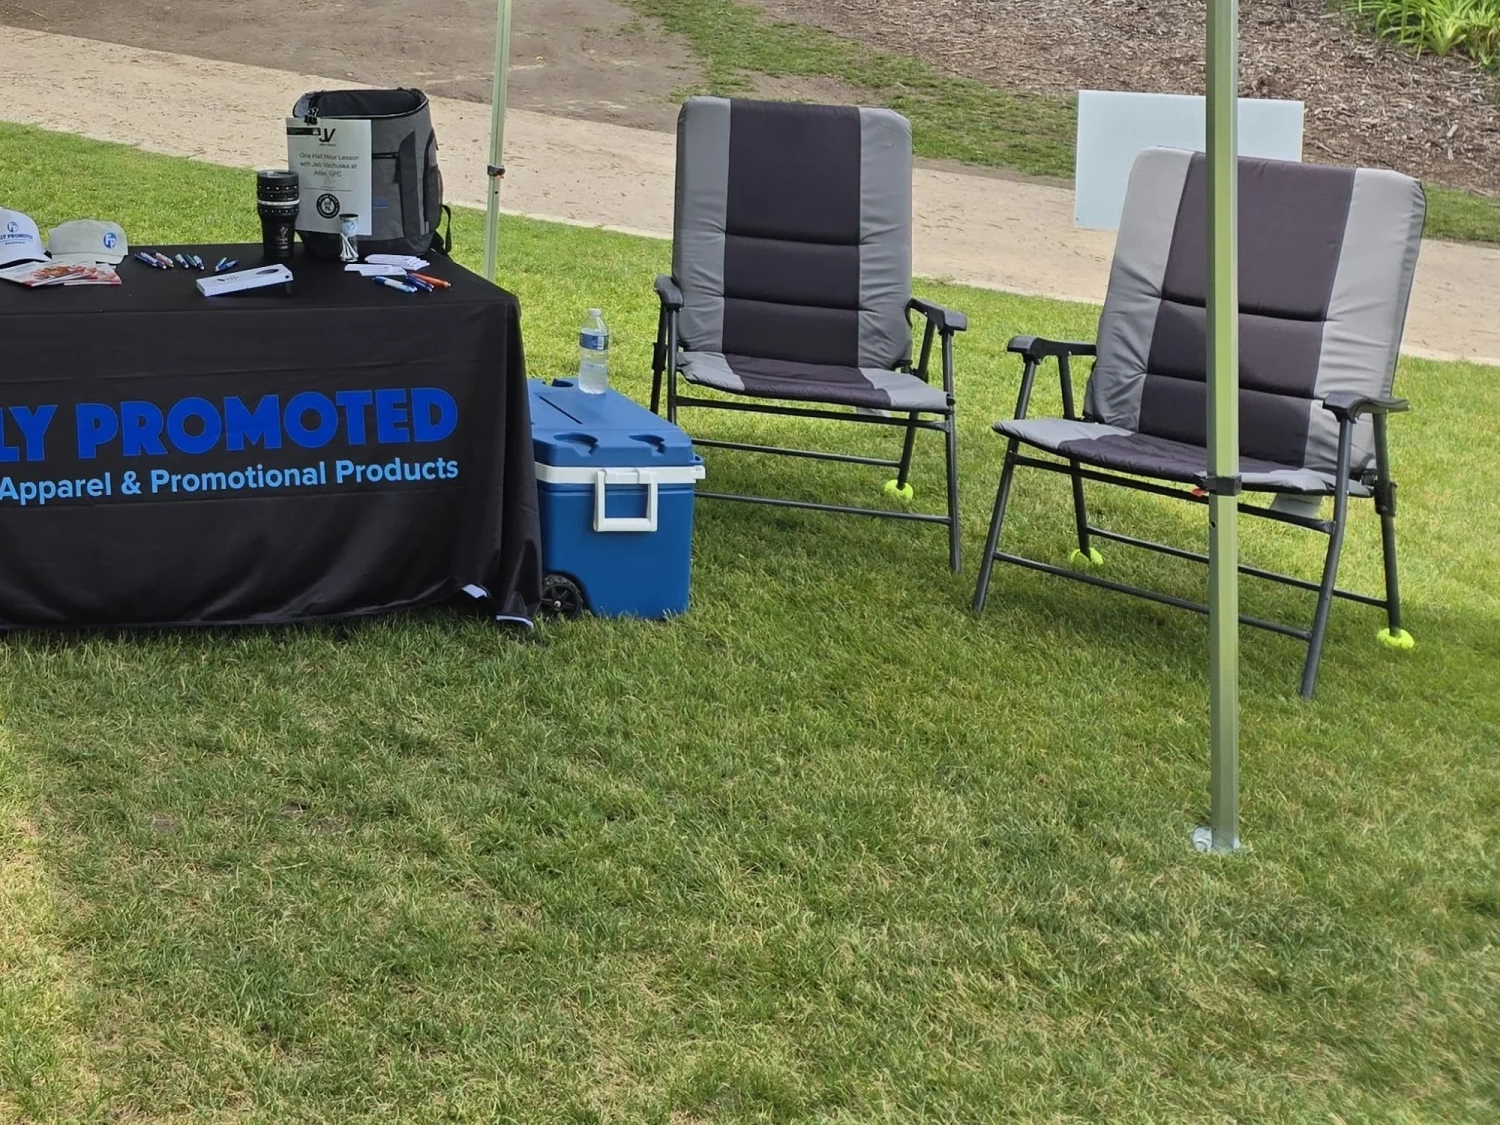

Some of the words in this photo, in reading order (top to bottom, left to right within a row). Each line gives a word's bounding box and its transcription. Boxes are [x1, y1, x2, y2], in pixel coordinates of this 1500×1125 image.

[74, 387, 458, 460] PROMOTED
[121, 470, 142, 495] &
[150, 461, 326, 494] Promotional
[335, 457, 459, 484] Products
